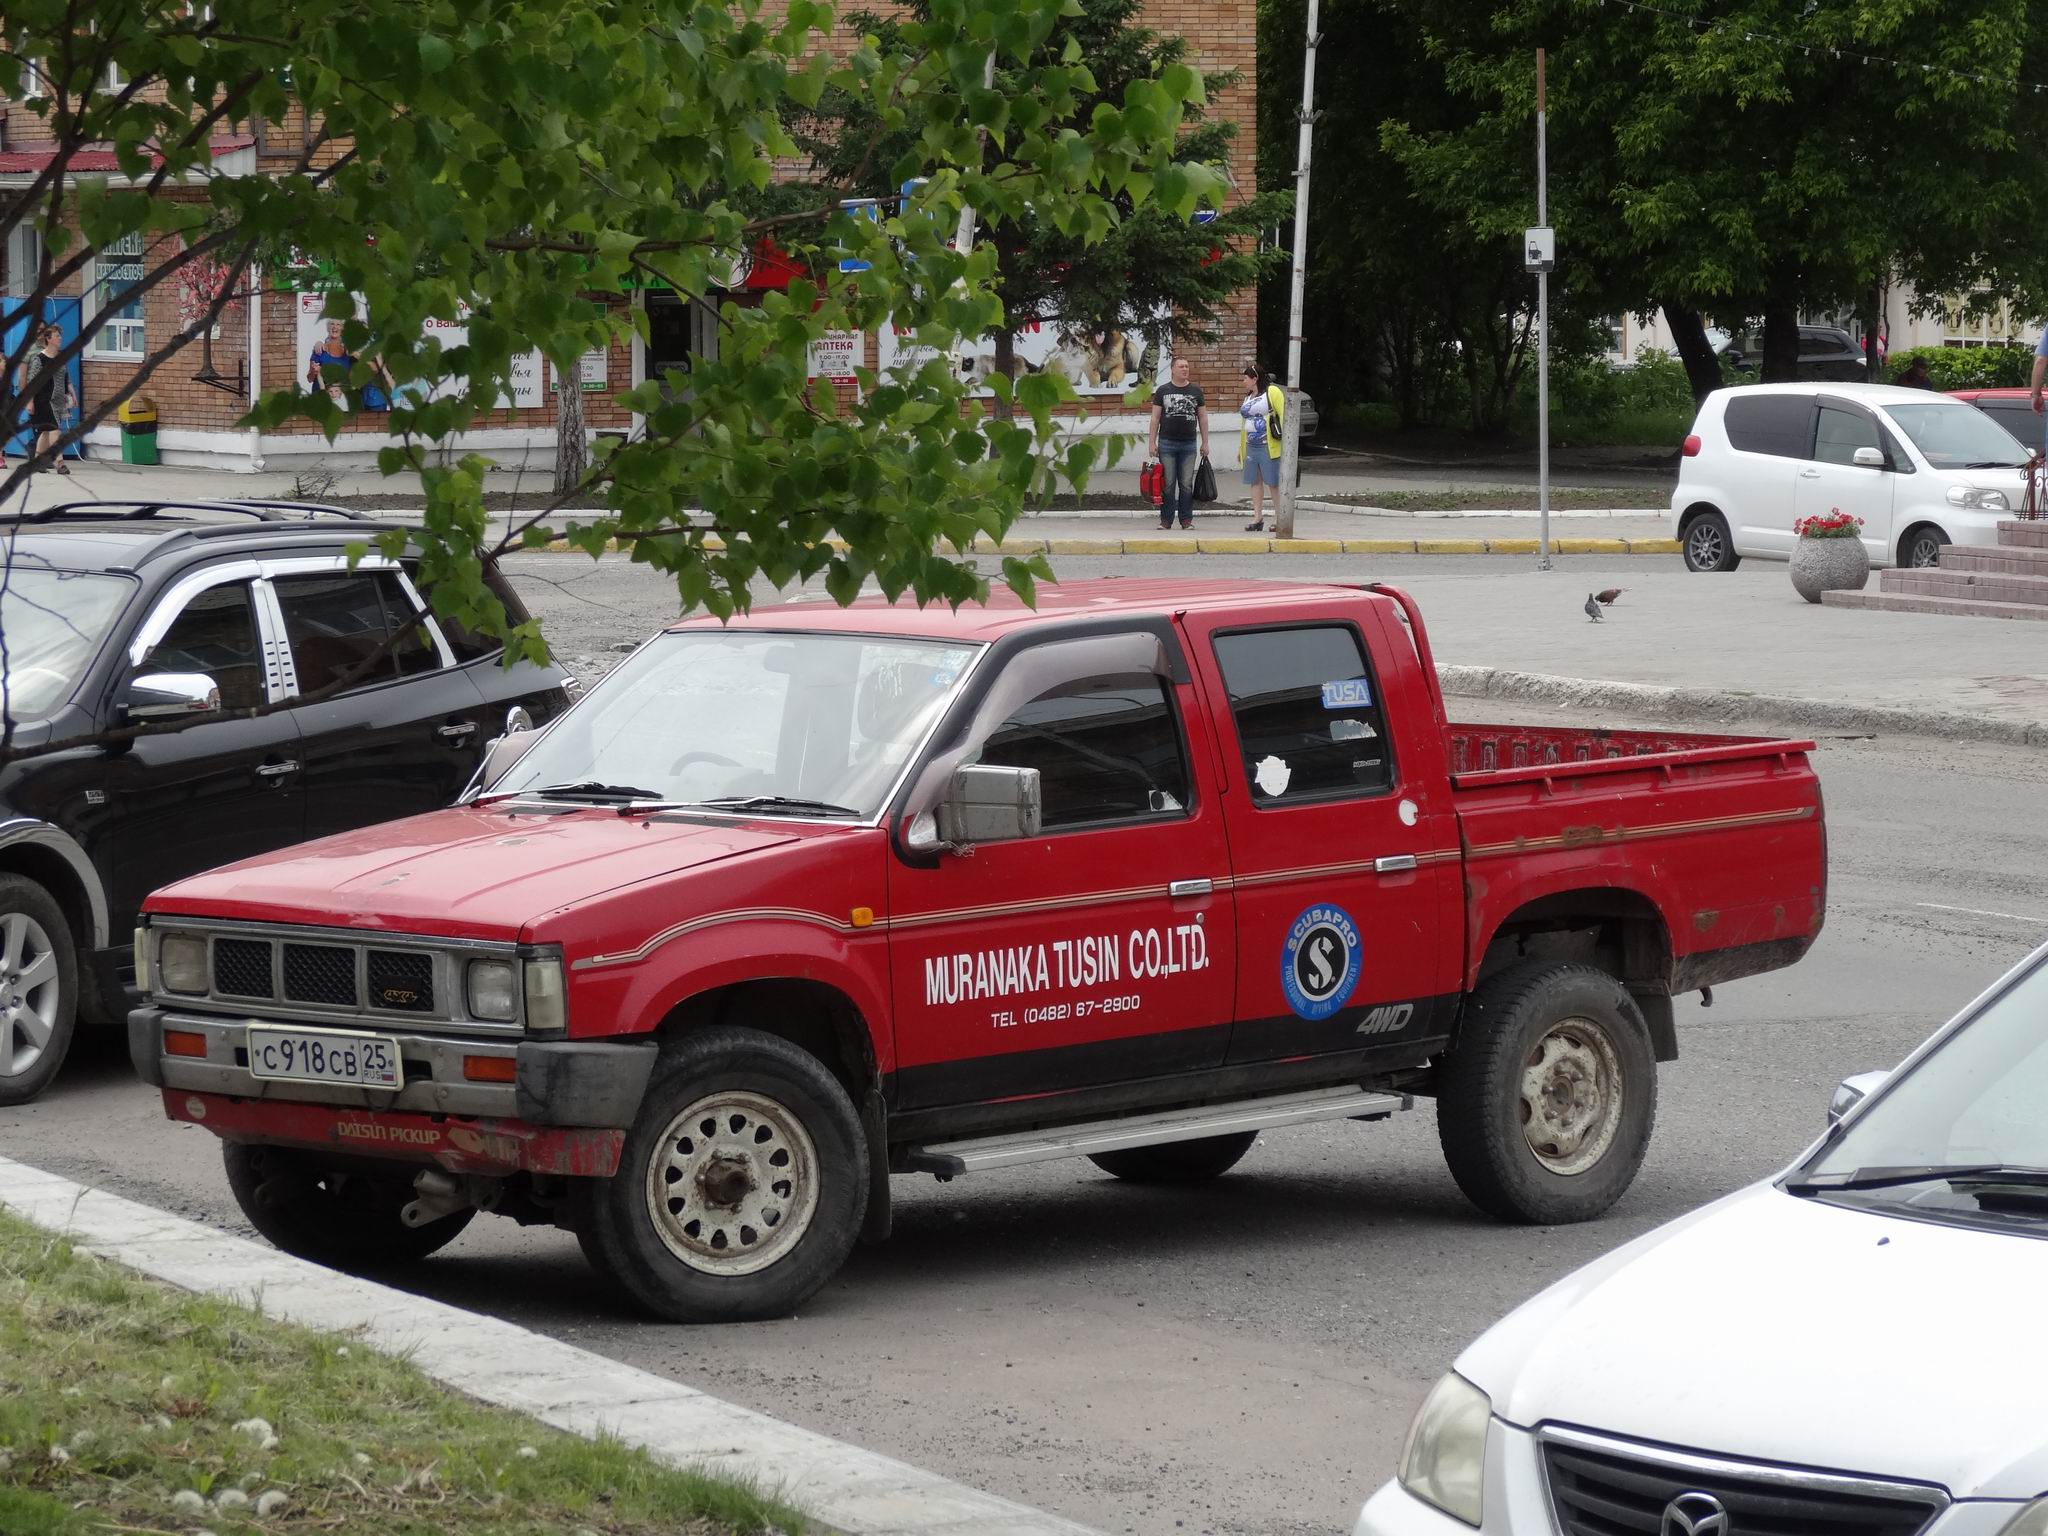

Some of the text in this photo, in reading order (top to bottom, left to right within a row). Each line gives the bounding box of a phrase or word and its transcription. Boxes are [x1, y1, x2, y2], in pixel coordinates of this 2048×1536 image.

[1287, 908, 1358, 952] SCUBAPRO
[925, 944, 1050, 1006] MURANAKA
[1053, 934, 1119, 989] TUSIN
[991, 995, 1141, 1028] TEL (0482) 67-2900
[1356, 1003, 1414, 1034] 4WD
[363, 1043, 387, 1070] 25
[363, 1069, 382, 1081] RUS
[390, 1126, 441, 1145] PICKUP
